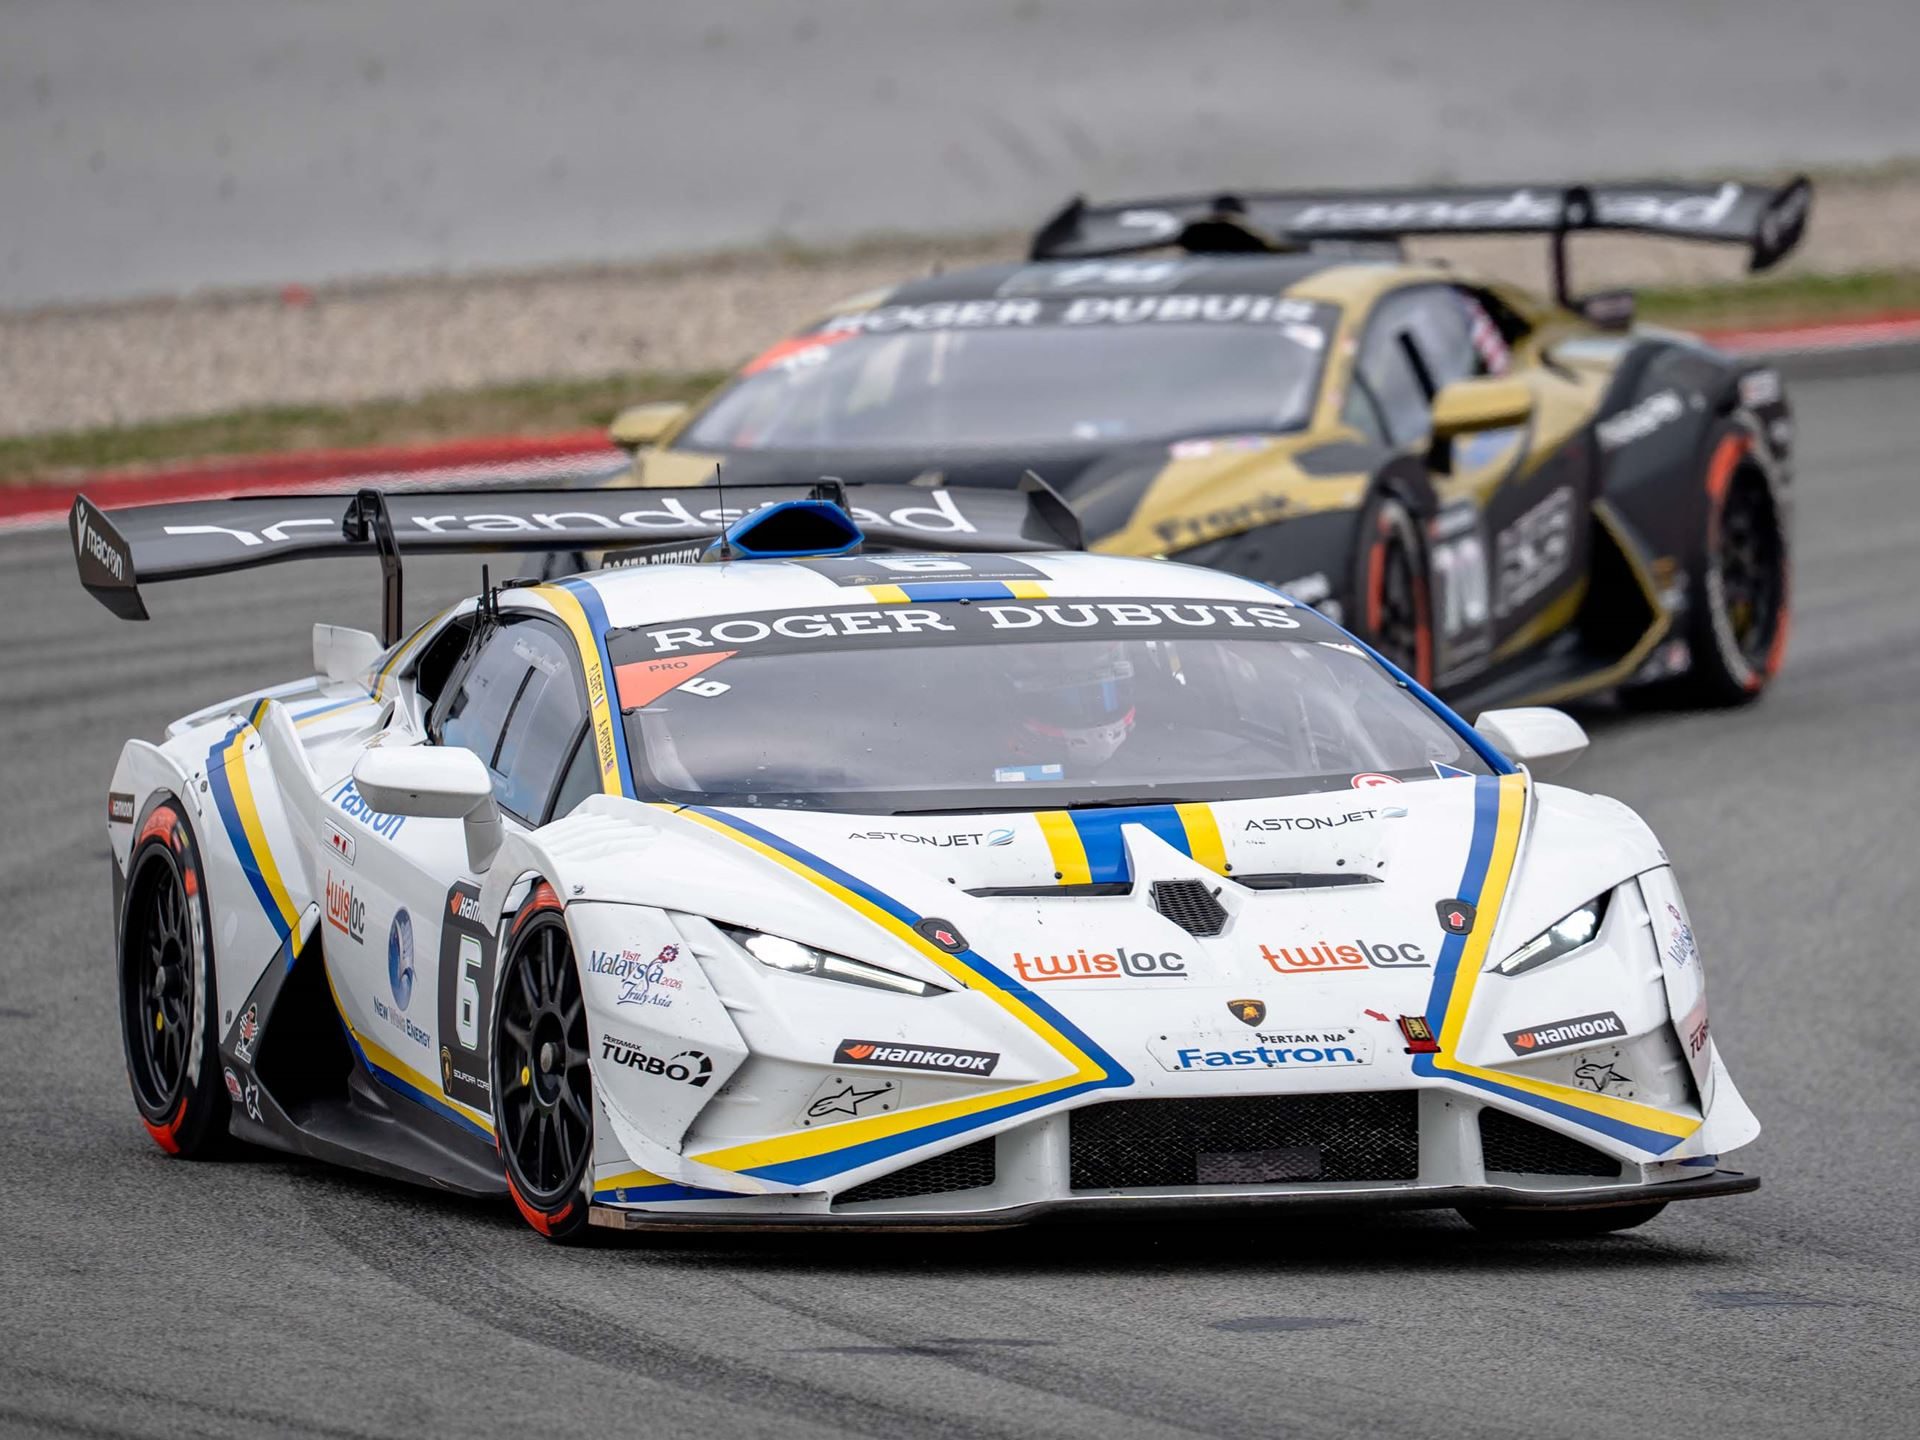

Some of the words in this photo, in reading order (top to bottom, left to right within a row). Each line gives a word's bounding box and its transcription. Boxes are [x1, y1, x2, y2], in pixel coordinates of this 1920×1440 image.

[1294, 182, 1742, 231] randsad
[411, 489, 978, 533] randsad
[87, 525, 123, 582] macron
[645, 609, 956, 653] ROGER
[978, 603, 1301, 629] DUBUIS
[648, 661, 688, 672] PRO
[1245, 809, 1378, 832] ASTONJET
[848, 831, 984, 848] ASTONJET
[1013, 948, 1188, 983] twisloc
[1259, 939, 1431, 974] twisloc
[456, 934, 482, 1051] 6
[648, 993, 673, 1008] Asia
[603, 1033, 642, 1051] PERTAMAX
[1177, 1045, 1356, 1069] Fastron
[602, 1042, 690, 1081] TURBO
